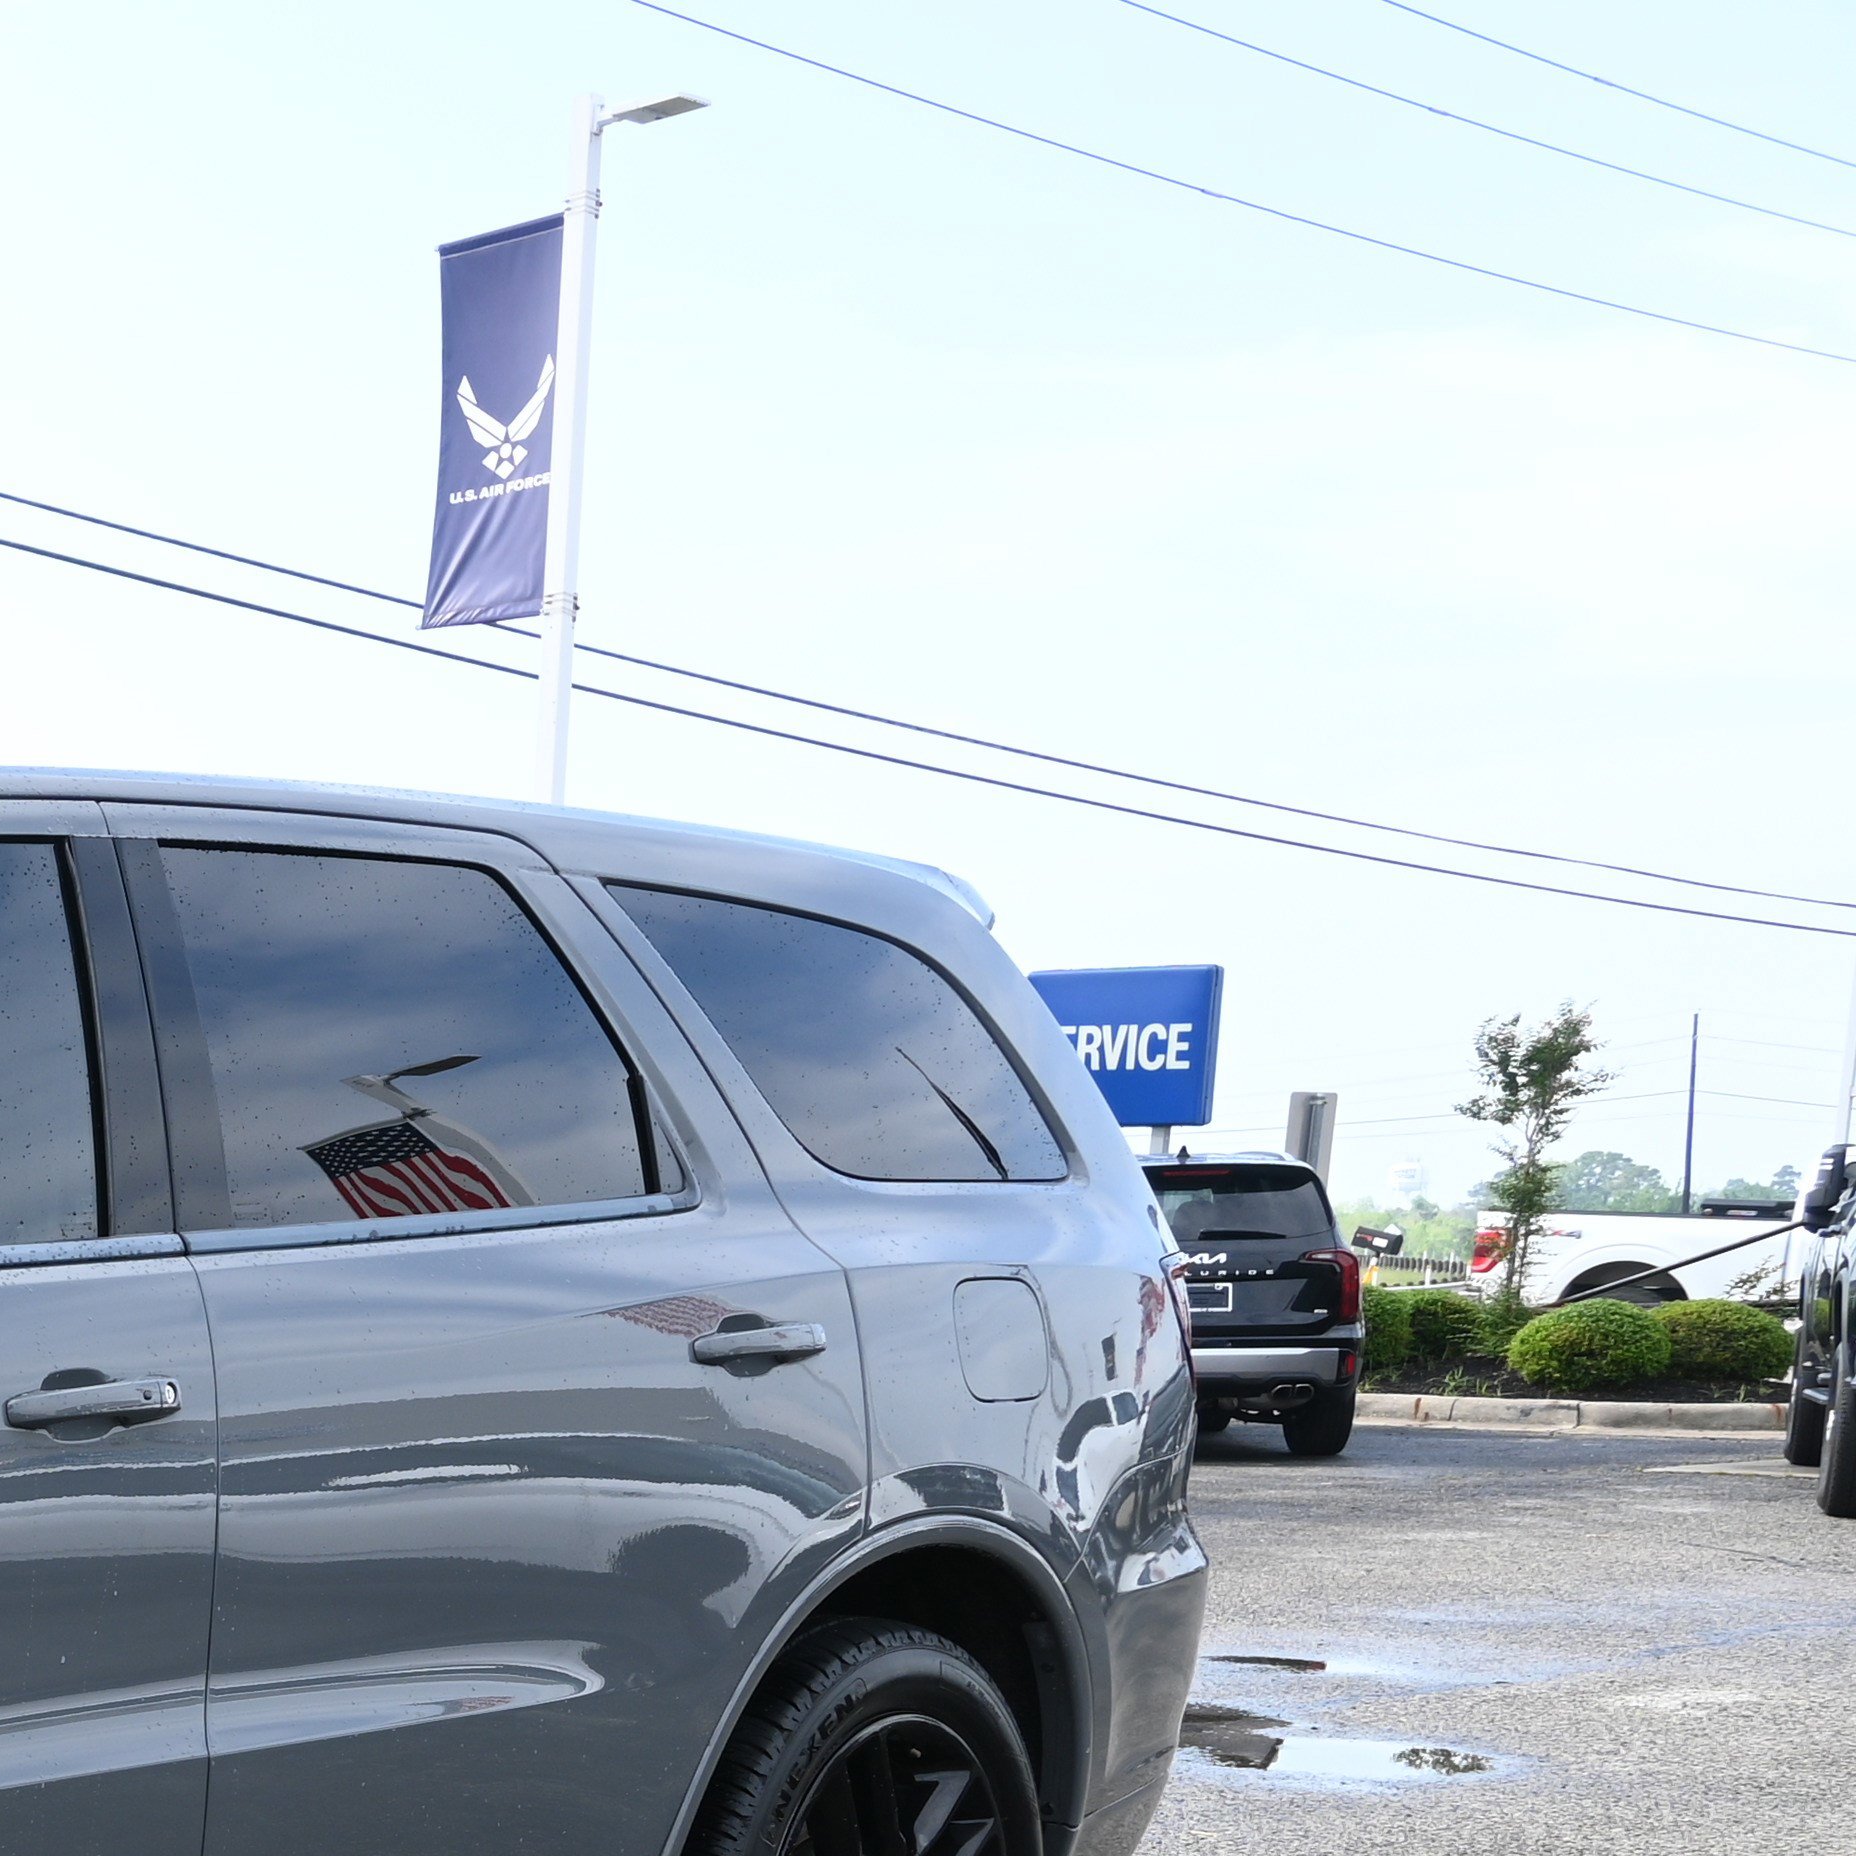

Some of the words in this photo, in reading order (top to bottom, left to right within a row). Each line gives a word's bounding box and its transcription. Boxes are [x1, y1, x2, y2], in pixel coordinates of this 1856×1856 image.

[449, 489, 478, 505] U.S.
[479, 483, 505, 499] AIR
[505, 471, 551, 494] FORCE
[1060, 1023, 1193, 1071] RVICE
